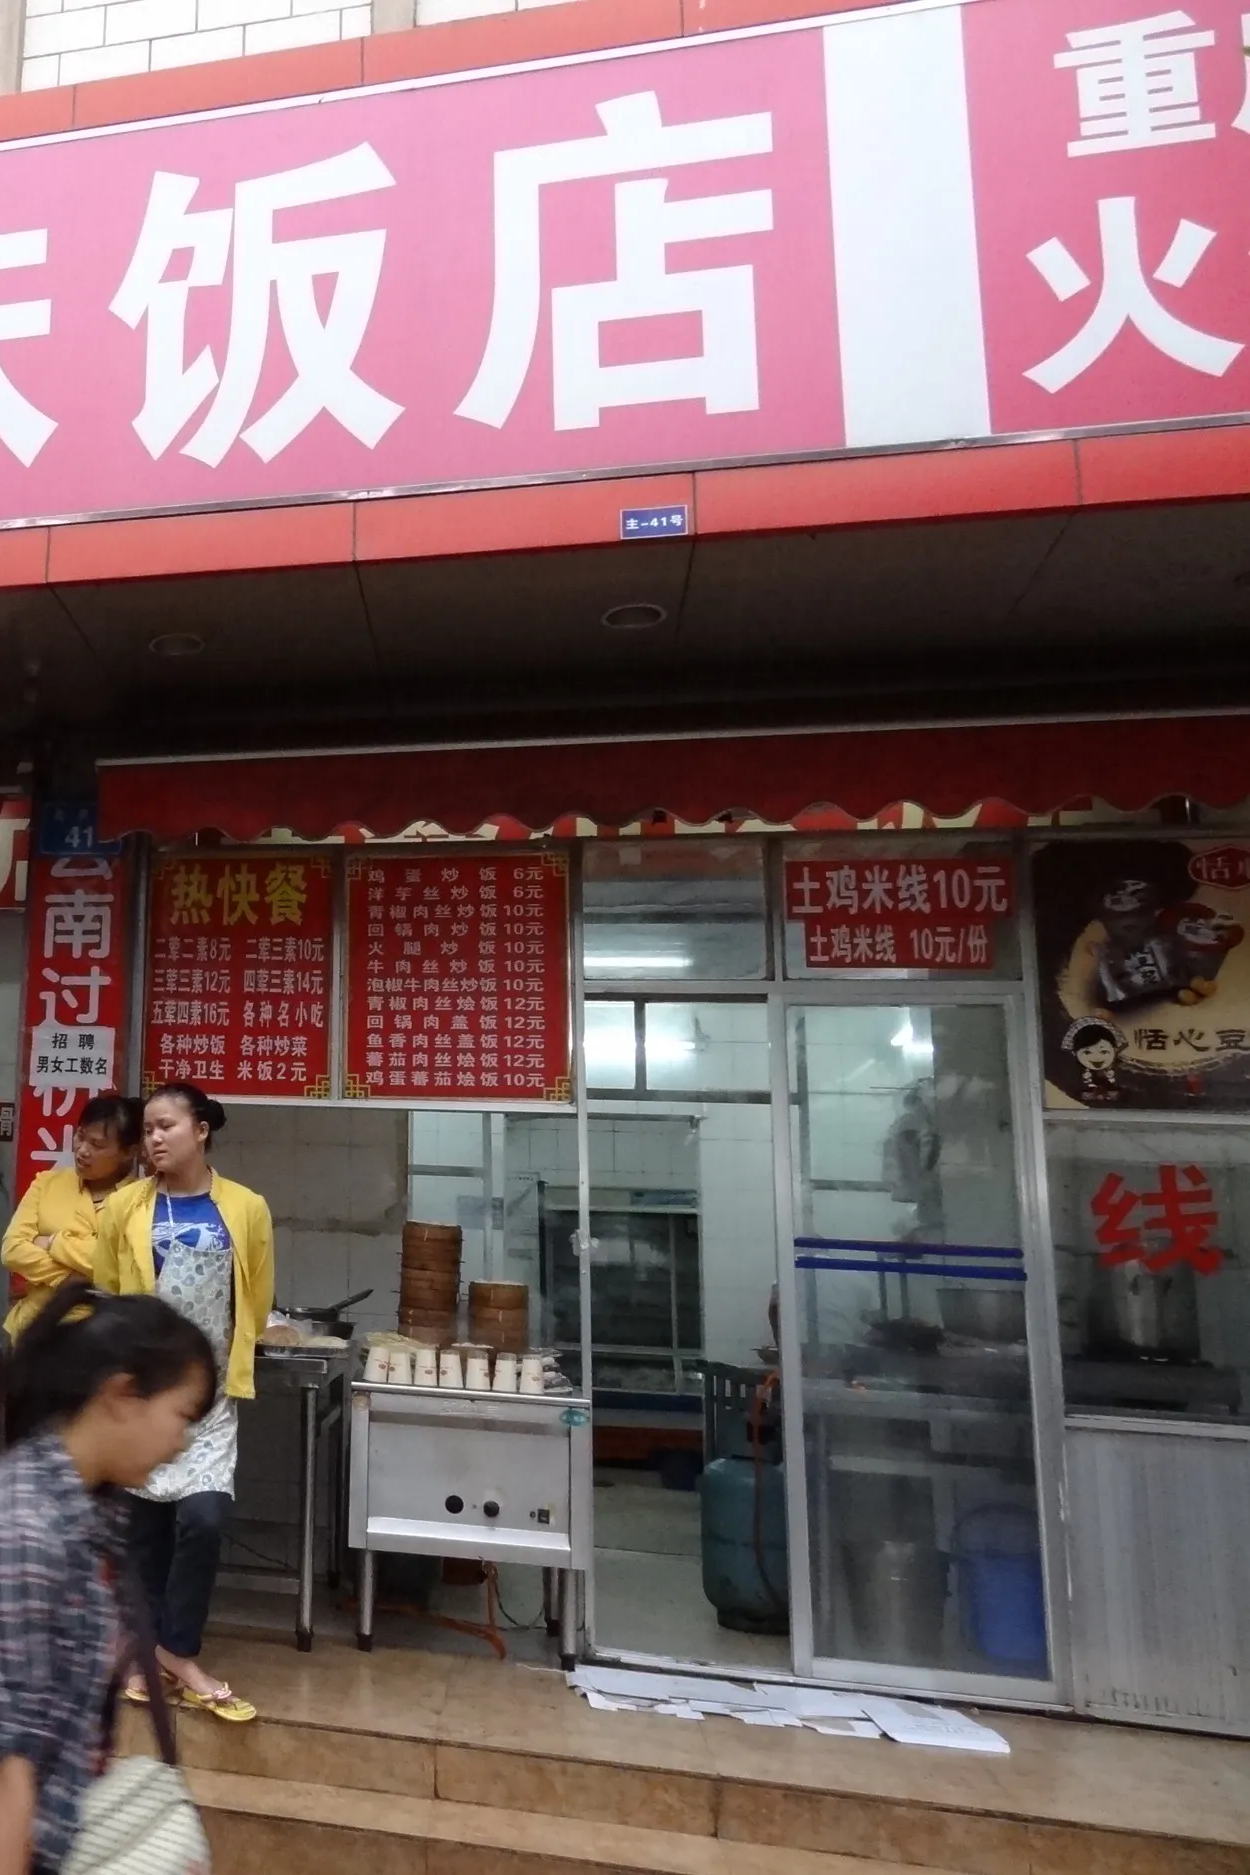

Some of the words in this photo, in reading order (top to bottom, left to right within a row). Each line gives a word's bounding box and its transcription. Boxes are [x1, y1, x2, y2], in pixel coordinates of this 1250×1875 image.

[1053, 10, 1250, 158] 重
[64, 826, 94, 849] 41
[169, 862, 307, 926] 热快餐
[791, 865, 1008, 915] 土鸡米线10元
[809, 925, 897, 963] 土鸡米线
[910, 925, 990, 965] 10元/份
[153, 968, 231, 994] 三荤三素12元
[243, 969, 324, 995] 四荤三素14元
[30, 855, 114, 1171] 云南过
[242, 1000, 323, 1028] 各种名小吃
[51, 1033, 96, 1050] 招聘
[160, 1033, 226, 1056] 各种炒饭
[240, 1034, 307, 1057] 各种炒菜
[36, 1055, 108, 1075] 男女工数名
[158, 1058, 225, 1080] 干净卫生
[1090, 1164, 1226, 1276] 线
